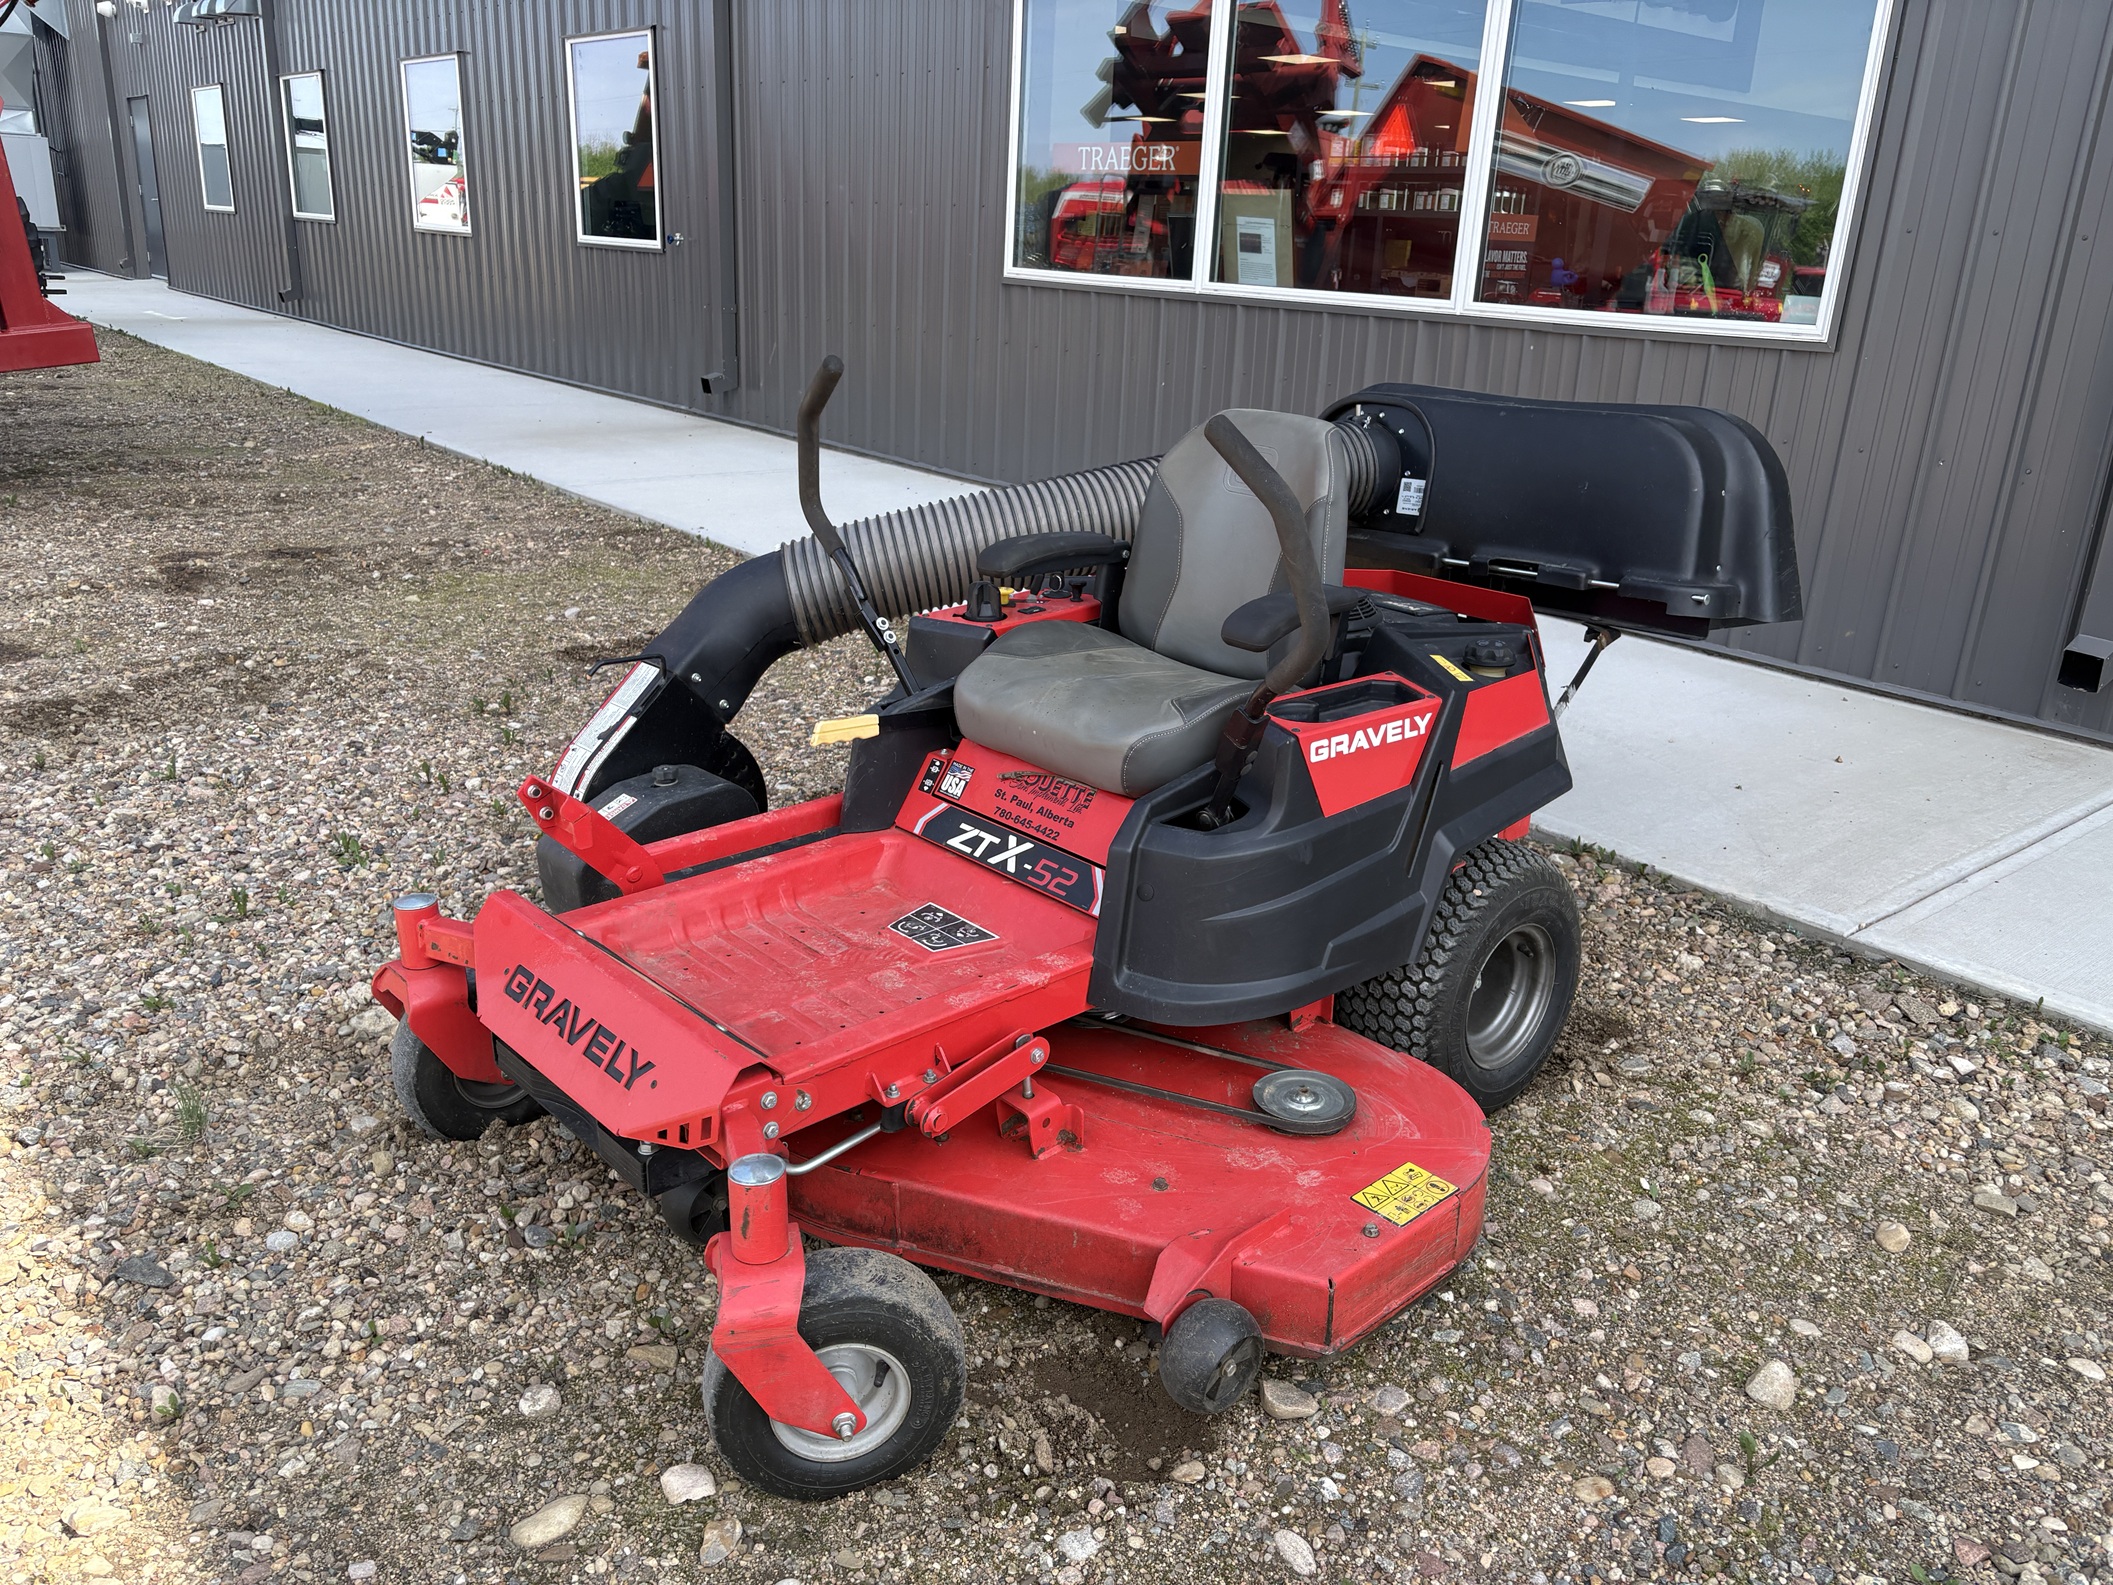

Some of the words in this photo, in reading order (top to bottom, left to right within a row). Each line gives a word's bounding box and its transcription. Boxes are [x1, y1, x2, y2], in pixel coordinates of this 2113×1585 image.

[1078, 145, 1176, 171] TRAEGER
[1310, 712, 1433, 763] GRAVELY
[940, 773, 967, 797] USA
[993, 806, 1060, 841] 780-645-4422
[994, 788, 1007, 801] St.
[1009, 794, 1034, 813] Paul,
[1036, 805, 1075, 828] Alberta
[504, 964, 657, 1091] GRAVELY
